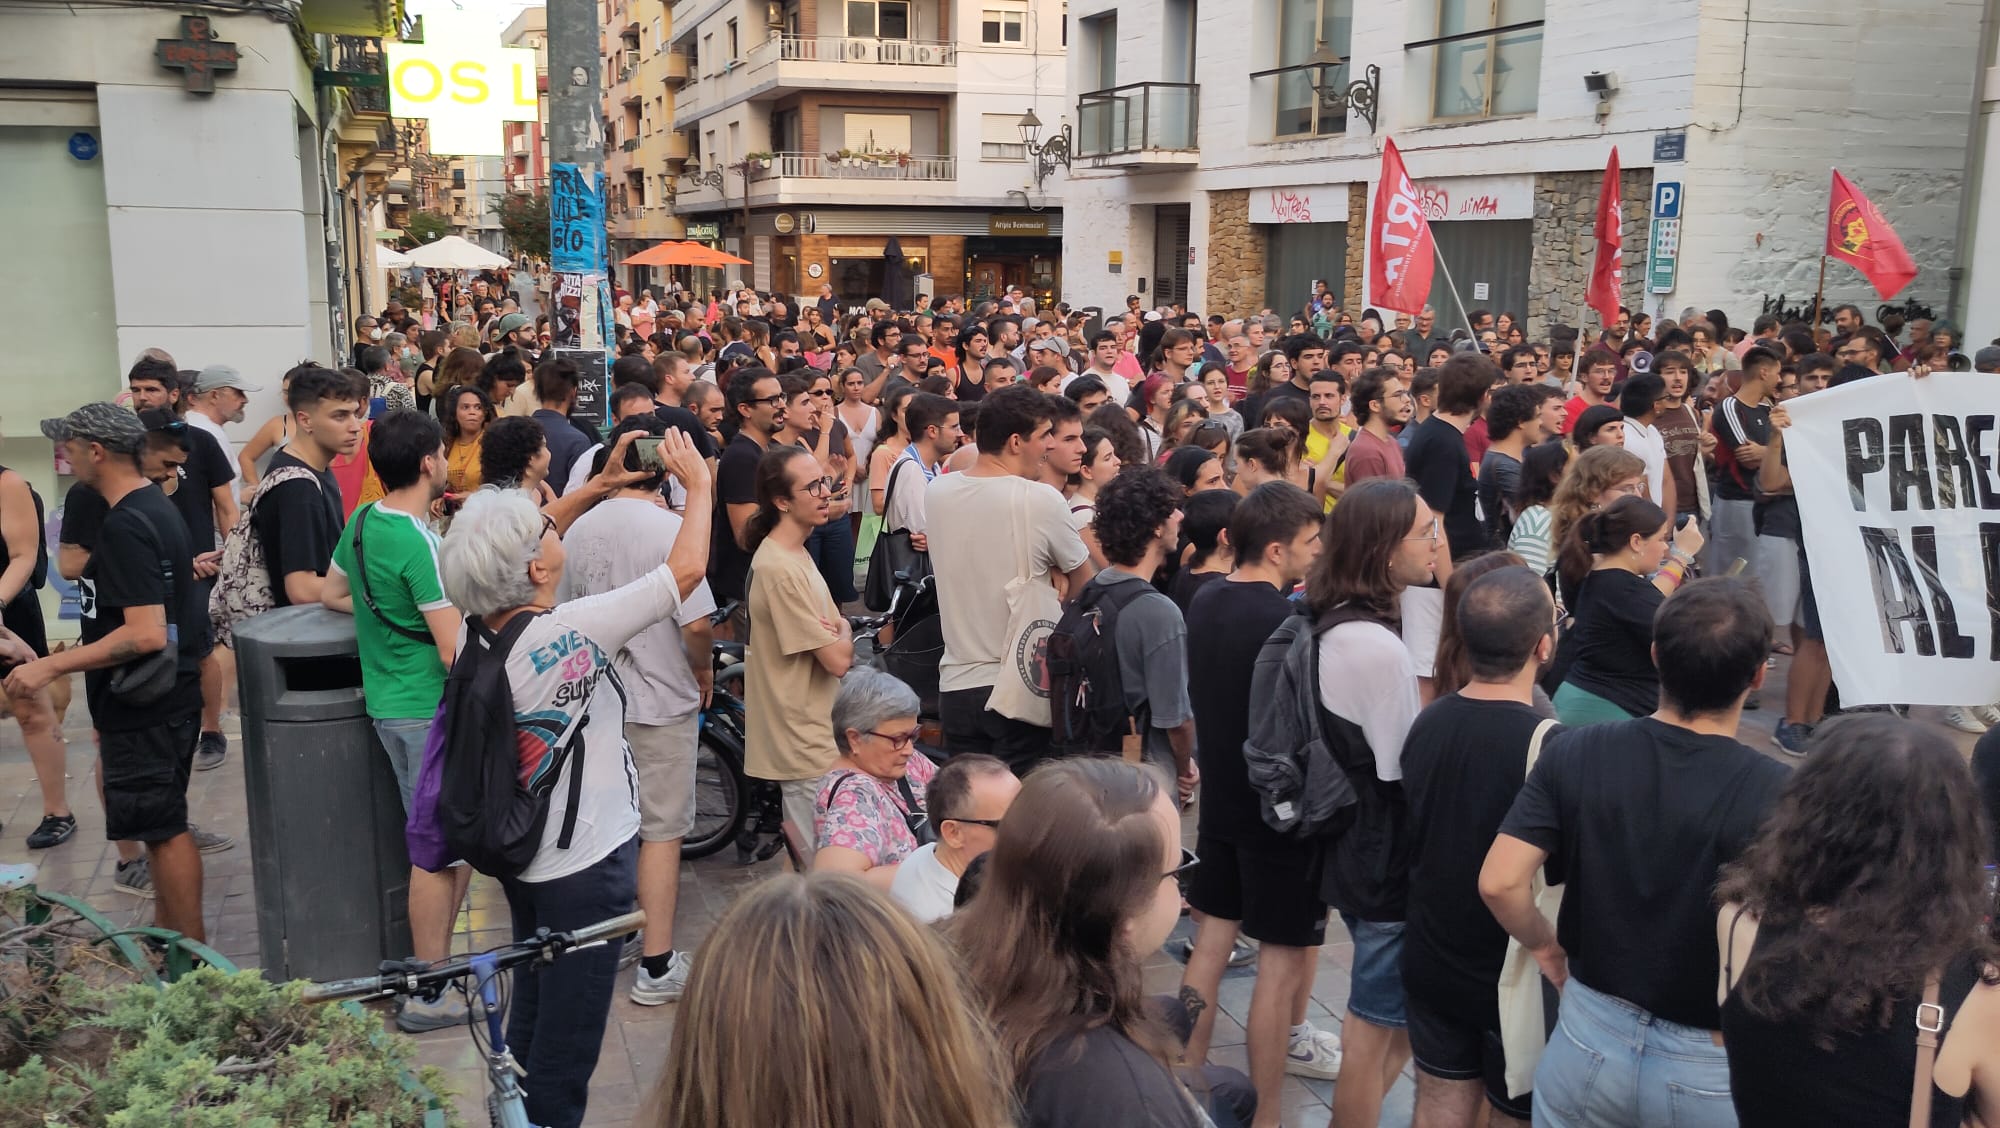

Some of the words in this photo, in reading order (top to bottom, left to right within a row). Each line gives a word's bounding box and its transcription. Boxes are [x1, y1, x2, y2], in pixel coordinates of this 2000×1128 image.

[1658, 186, 1675, 214] P
[1842, 413, 2000, 512] PARE
[1859, 526, 1975, 659] AL
[562, 649, 592, 681] IS
